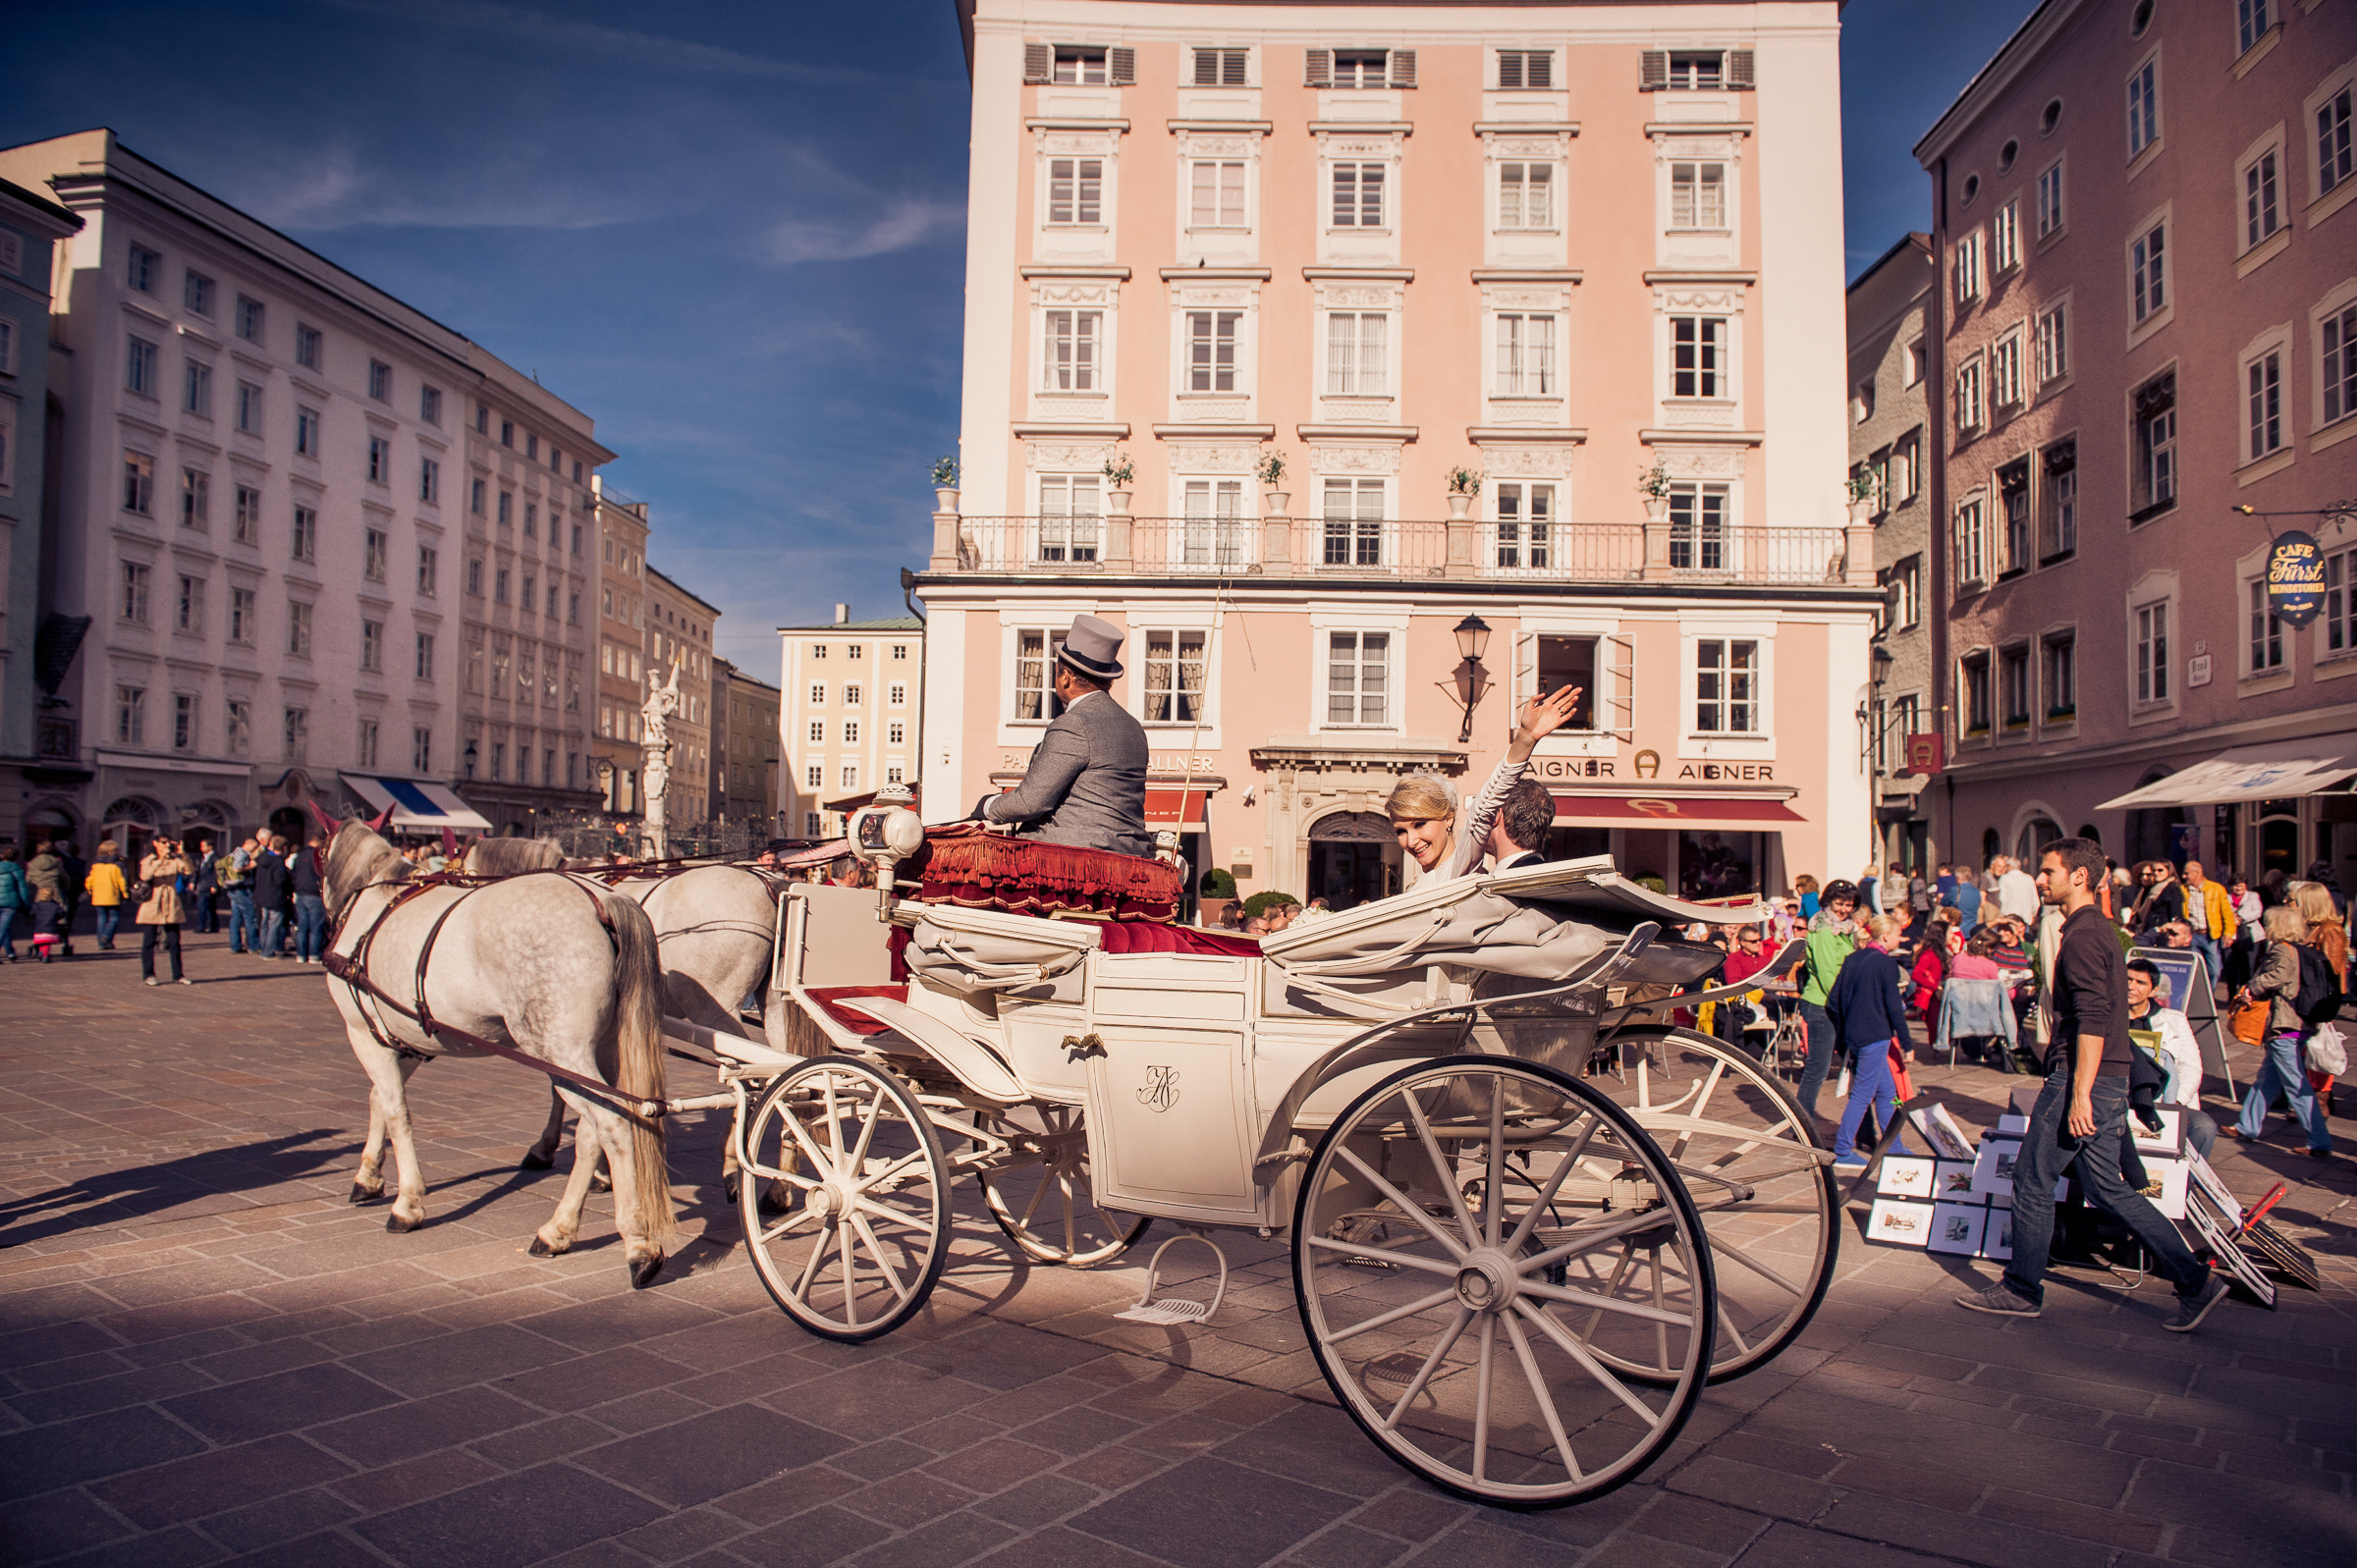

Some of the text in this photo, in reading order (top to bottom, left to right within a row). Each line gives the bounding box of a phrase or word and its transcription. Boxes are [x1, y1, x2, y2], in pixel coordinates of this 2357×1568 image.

[2275, 543, 2315, 559] CAFE
[2269, 557, 2325, 583] Fürst
[2269, 582, 2326, 594] KONDITOREI
[1003, 753, 1214, 772] PAU ALLNER
[1523, 762, 1616, 777] AIGNER
[1678, 764, 1774, 781] AIGNER
